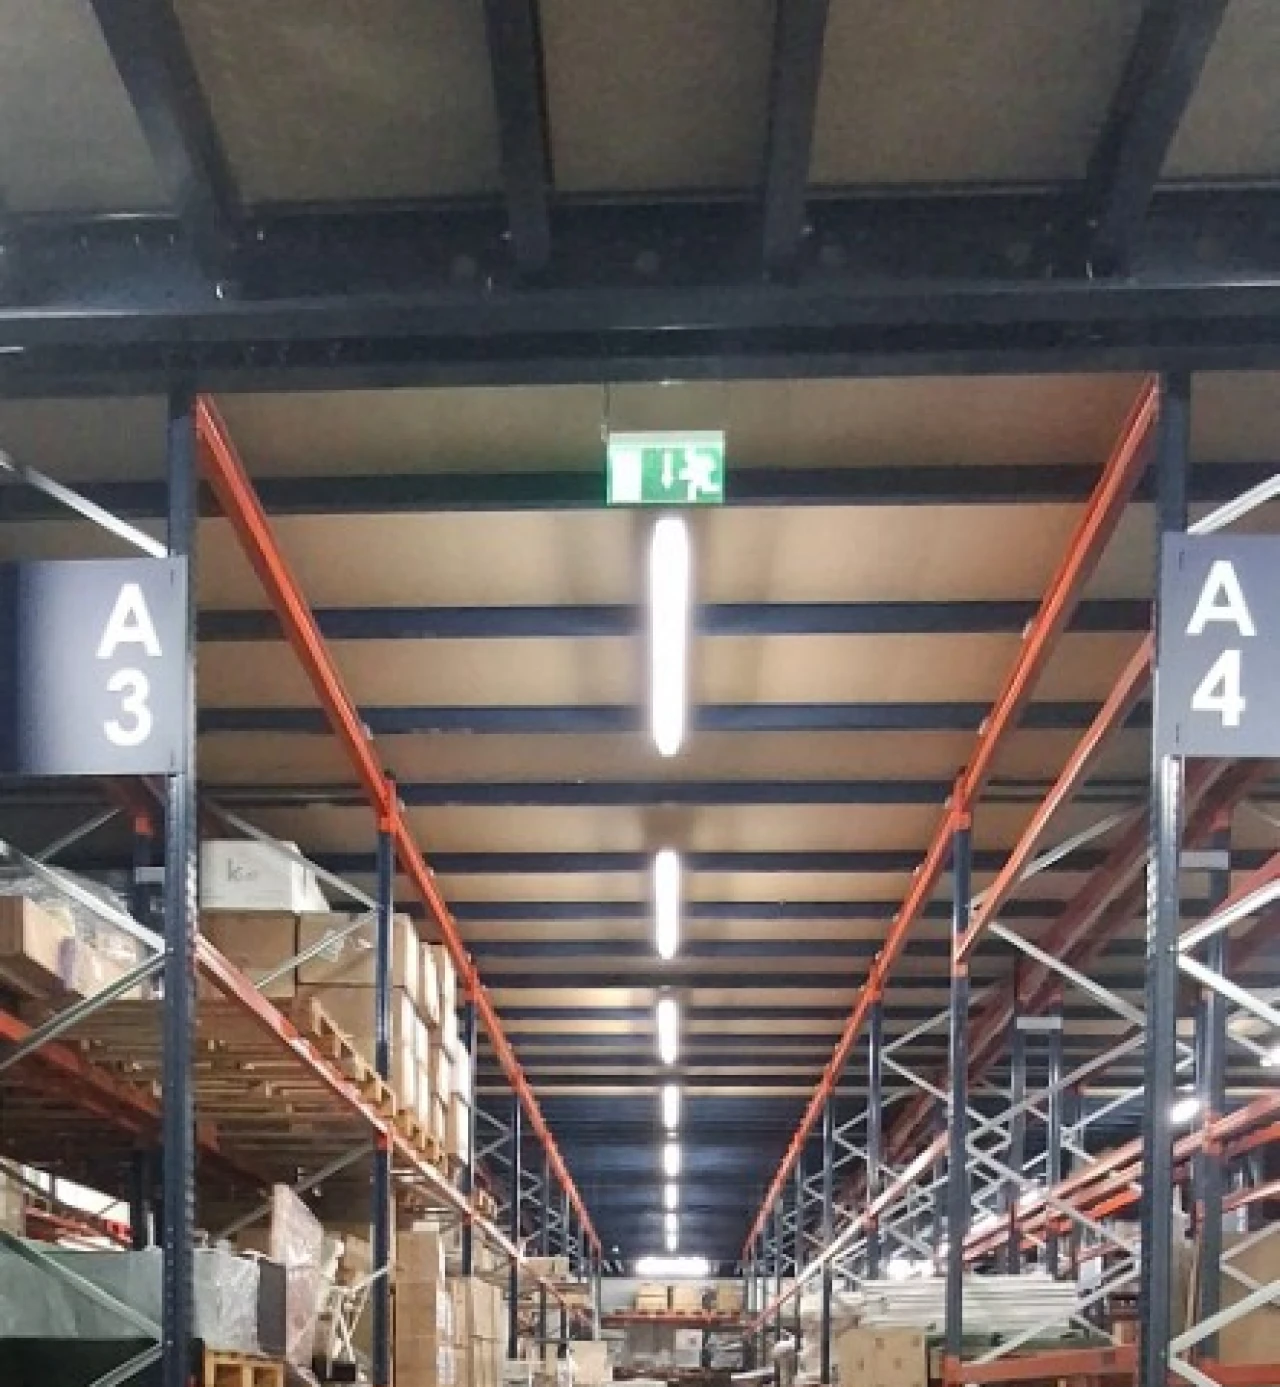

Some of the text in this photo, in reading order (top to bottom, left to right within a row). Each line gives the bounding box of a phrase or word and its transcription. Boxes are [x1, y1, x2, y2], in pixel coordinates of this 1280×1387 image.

[96, 583, 163, 659] A
[1185, 560, 1257, 636] A
[103, 668, 153, 745] 3
[1191, 649, 1246, 728] 4
